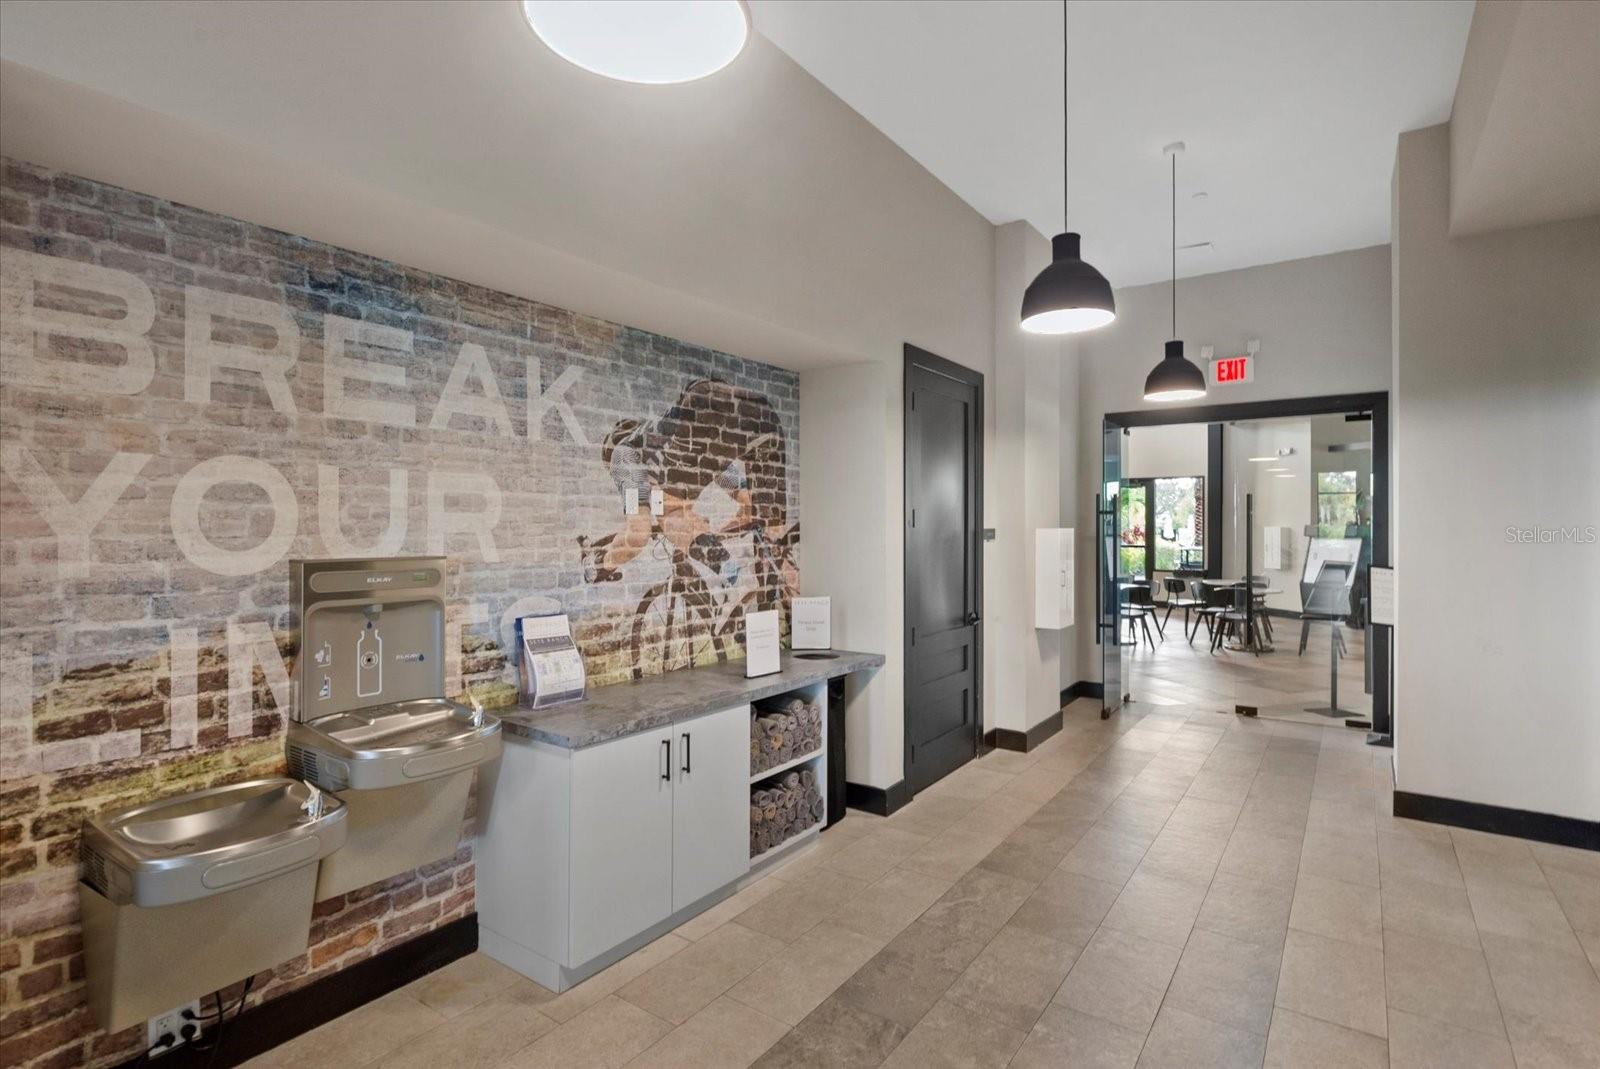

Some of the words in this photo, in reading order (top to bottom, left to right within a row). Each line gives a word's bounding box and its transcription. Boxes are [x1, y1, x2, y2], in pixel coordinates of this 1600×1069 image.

[0, 246, 588, 446] BREAK
[1217, 357, 1247, 382] EXIT
[0, 450, 502, 578] YOUR
[366, 576, 393, 584] ELKAY
